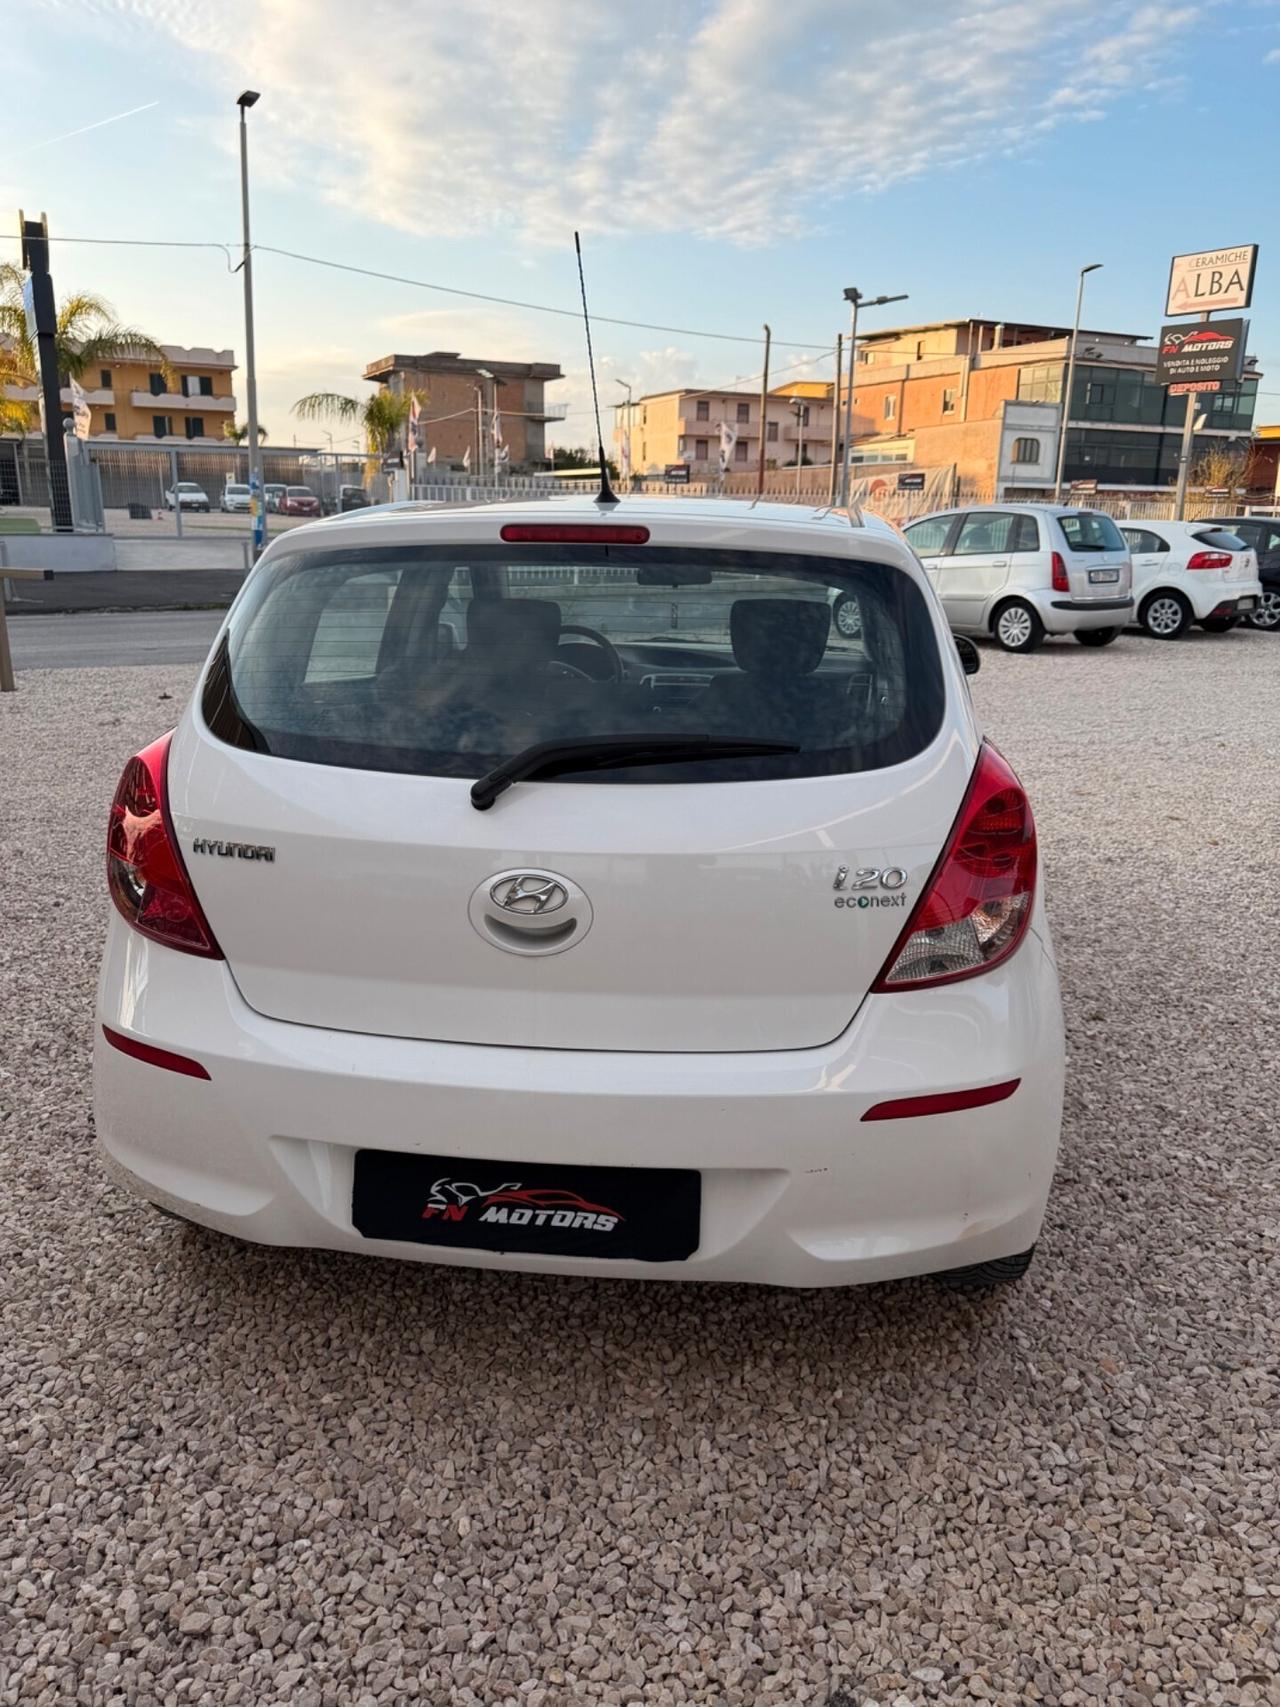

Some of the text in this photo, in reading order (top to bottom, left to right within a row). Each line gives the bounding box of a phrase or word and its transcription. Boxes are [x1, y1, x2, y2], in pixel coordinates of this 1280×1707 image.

[1188, 250, 1249, 268] CERAMICHE
[1171, 268, 1245, 301] ALBA
[1162, 340, 1234, 354] FN MOTORS
[1163, 360, 1190, 368] VENDITA
[1195, 356, 1229, 366] NOLEGGIO
[1169, 367, 1177, 375] DI
[1177, 366, 1195, 374] AUTO
[1200, 364, 1221, 372] MOTO
[1169, 381, 1221, 393] DEPOSITO
[193, 838, 276, 863] HYUNDAI
[834, 892, 907, 909] econext
[421, 1203, 619, 1232] FN MOTORS
